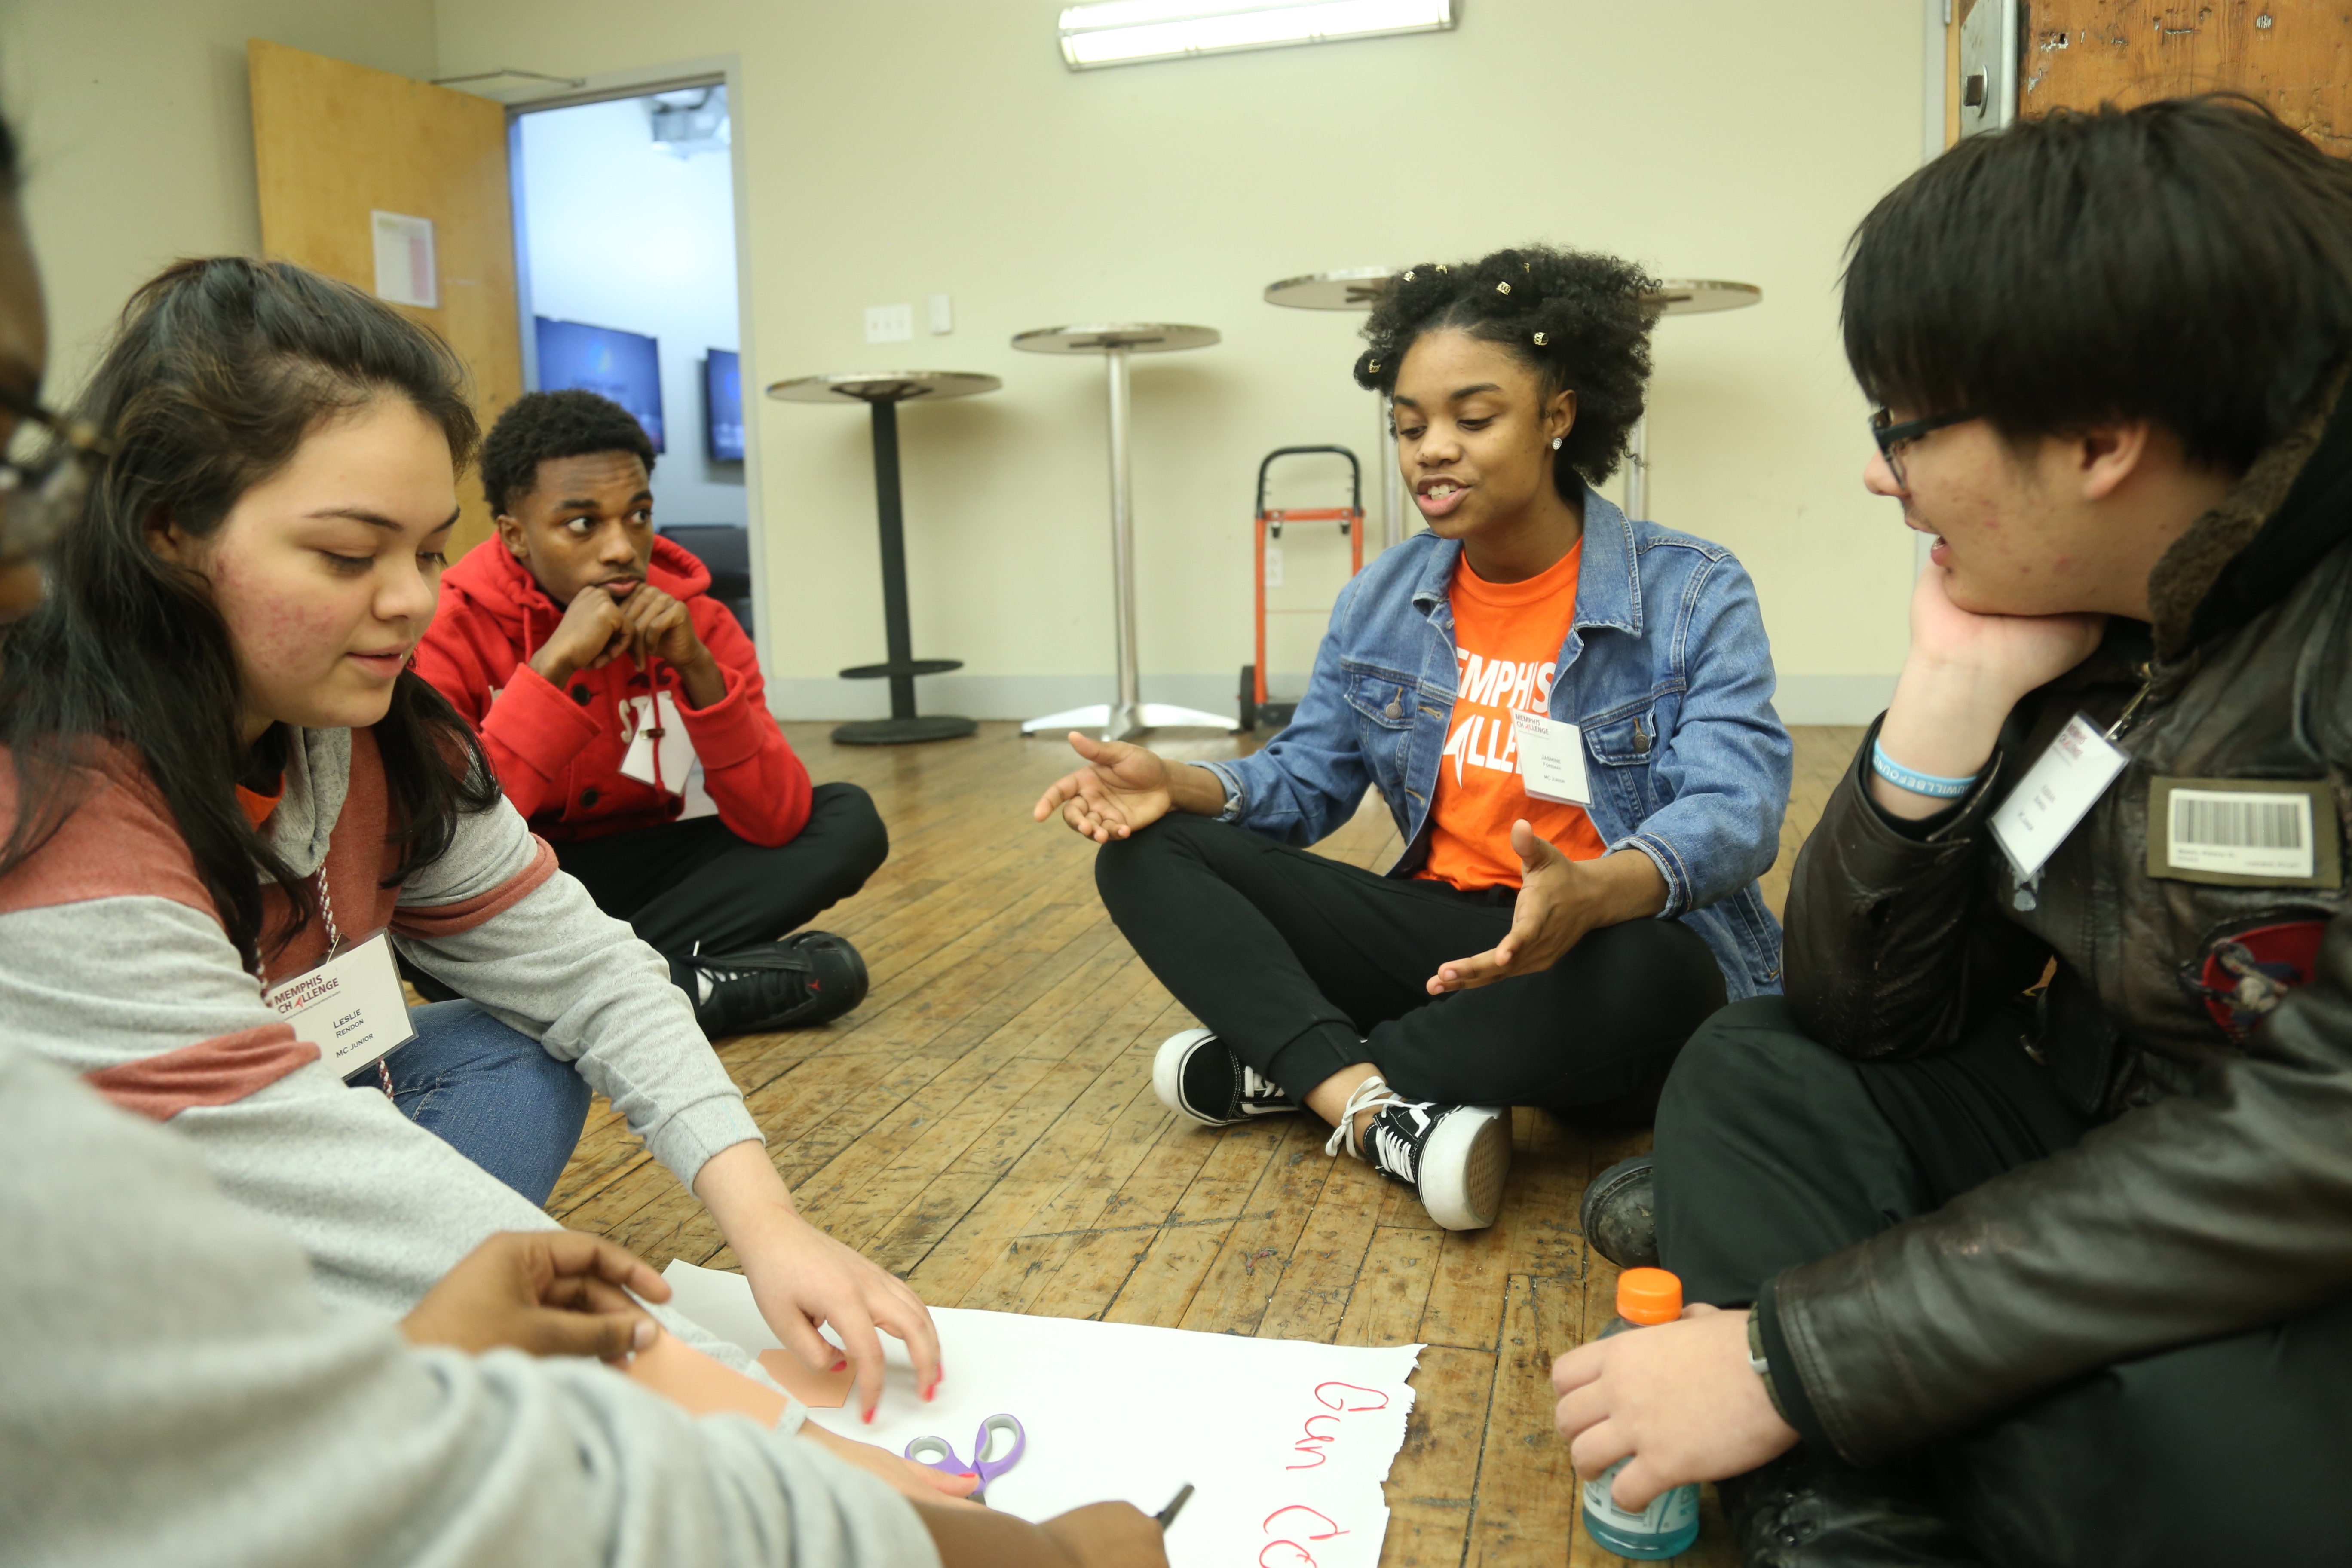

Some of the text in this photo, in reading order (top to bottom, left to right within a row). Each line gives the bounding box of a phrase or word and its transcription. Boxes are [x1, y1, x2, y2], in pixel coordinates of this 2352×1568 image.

[1516, 714, 1540, 726] MEMPHIS
[1517, 721, 1549, 735] CHALLENGE
[274, 975, 322, 1004] MEMPHIS
[278, 978, 339, 1014] CHALLENGE
[333, 1008, 361, 1029] LESLIE
[336, 1019, 364, 1038] RENDON
[336, 1033, 374, 1058] MC JUNIOR
[1286, 1381, 1389, 1470] Gun
